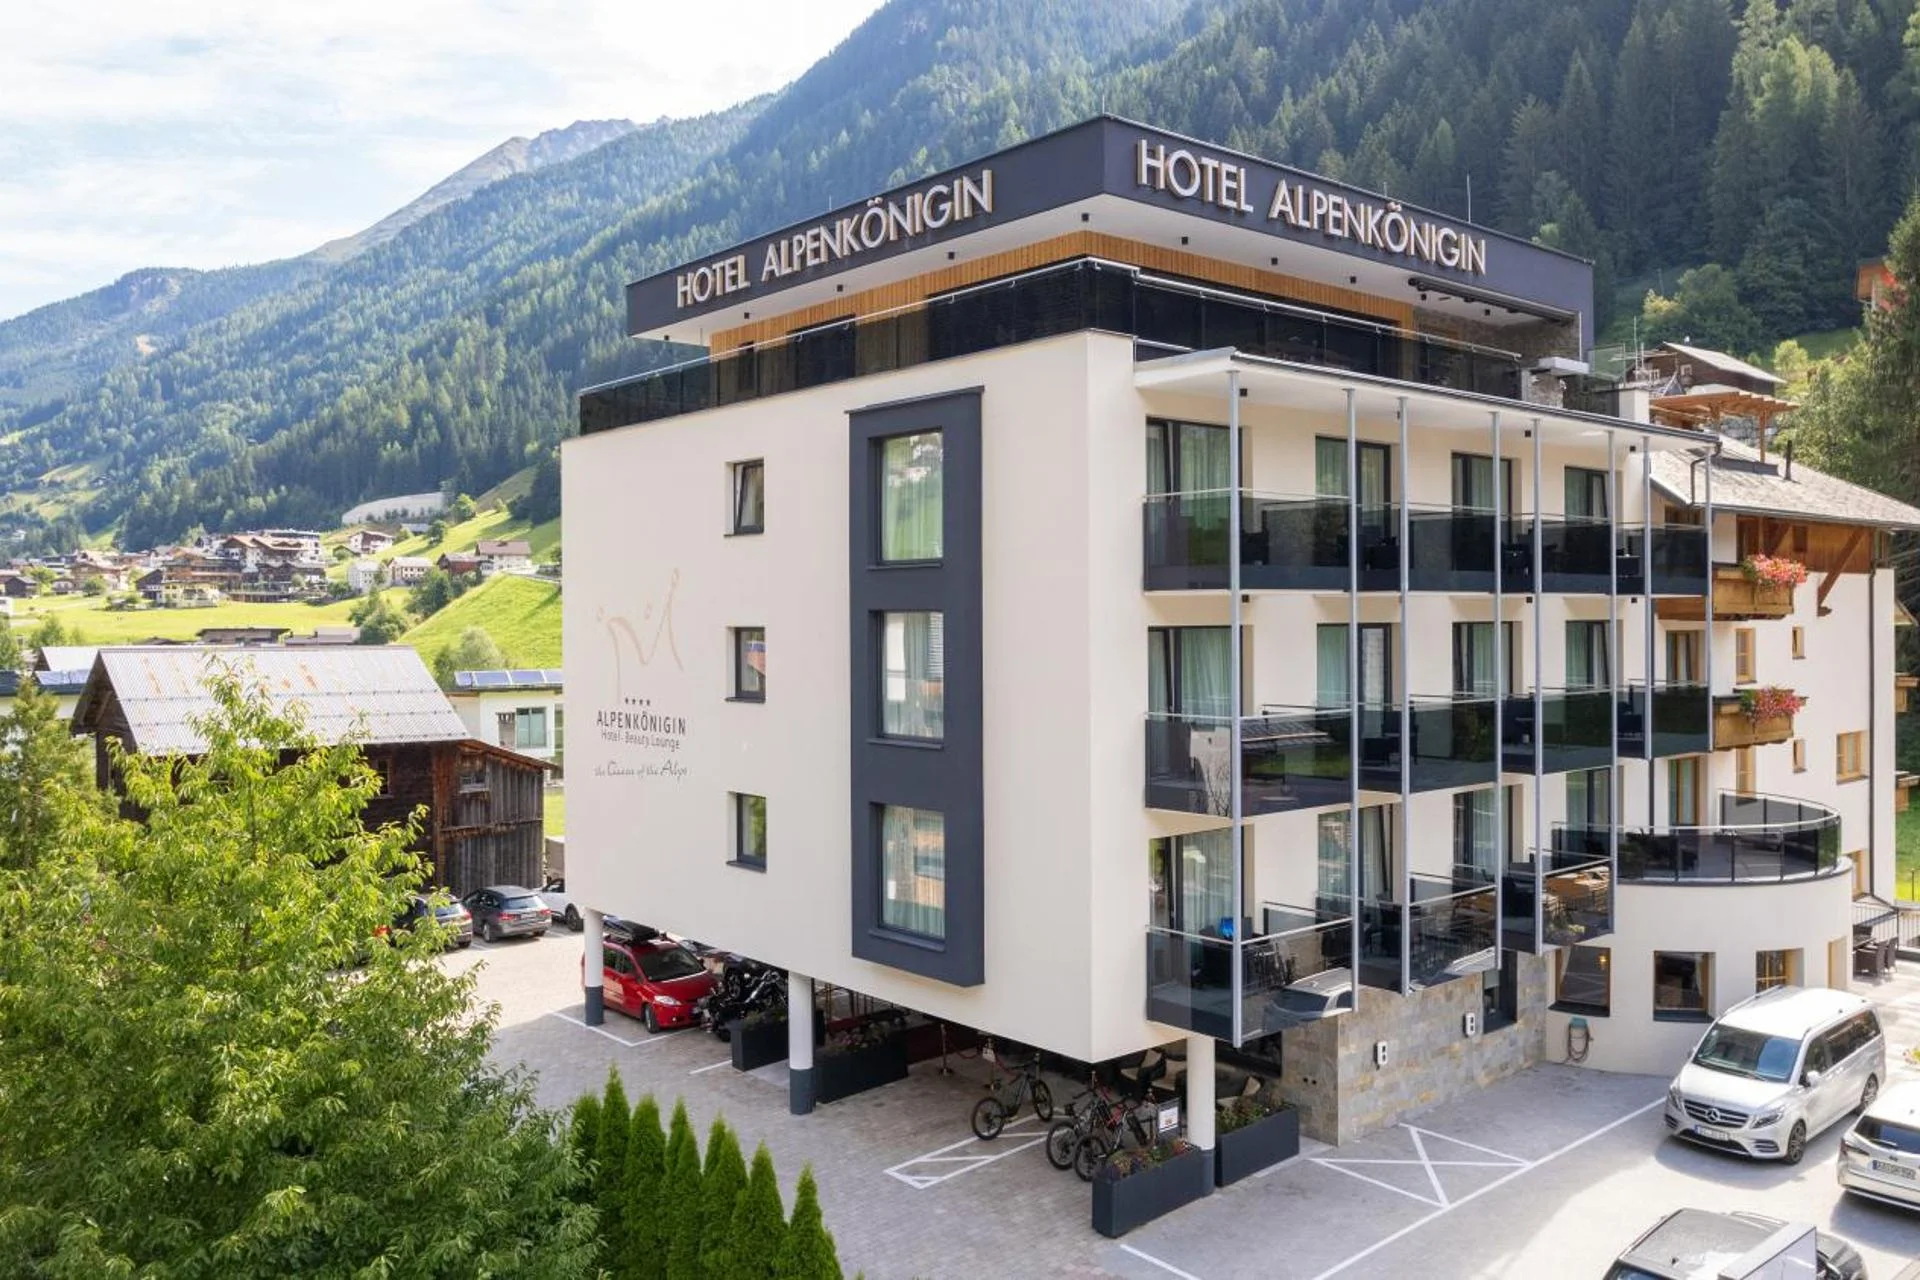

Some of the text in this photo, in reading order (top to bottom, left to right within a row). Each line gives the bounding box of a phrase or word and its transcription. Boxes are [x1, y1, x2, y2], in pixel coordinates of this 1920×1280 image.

[676, 169, 993, 308] HOTEL ALPENKÖNIGIN
[1136, 138, 1486, 275] HOTEL ALPENKÖNIGIN
[597, 709, 686, 736] ALPENKÖNIGIN
